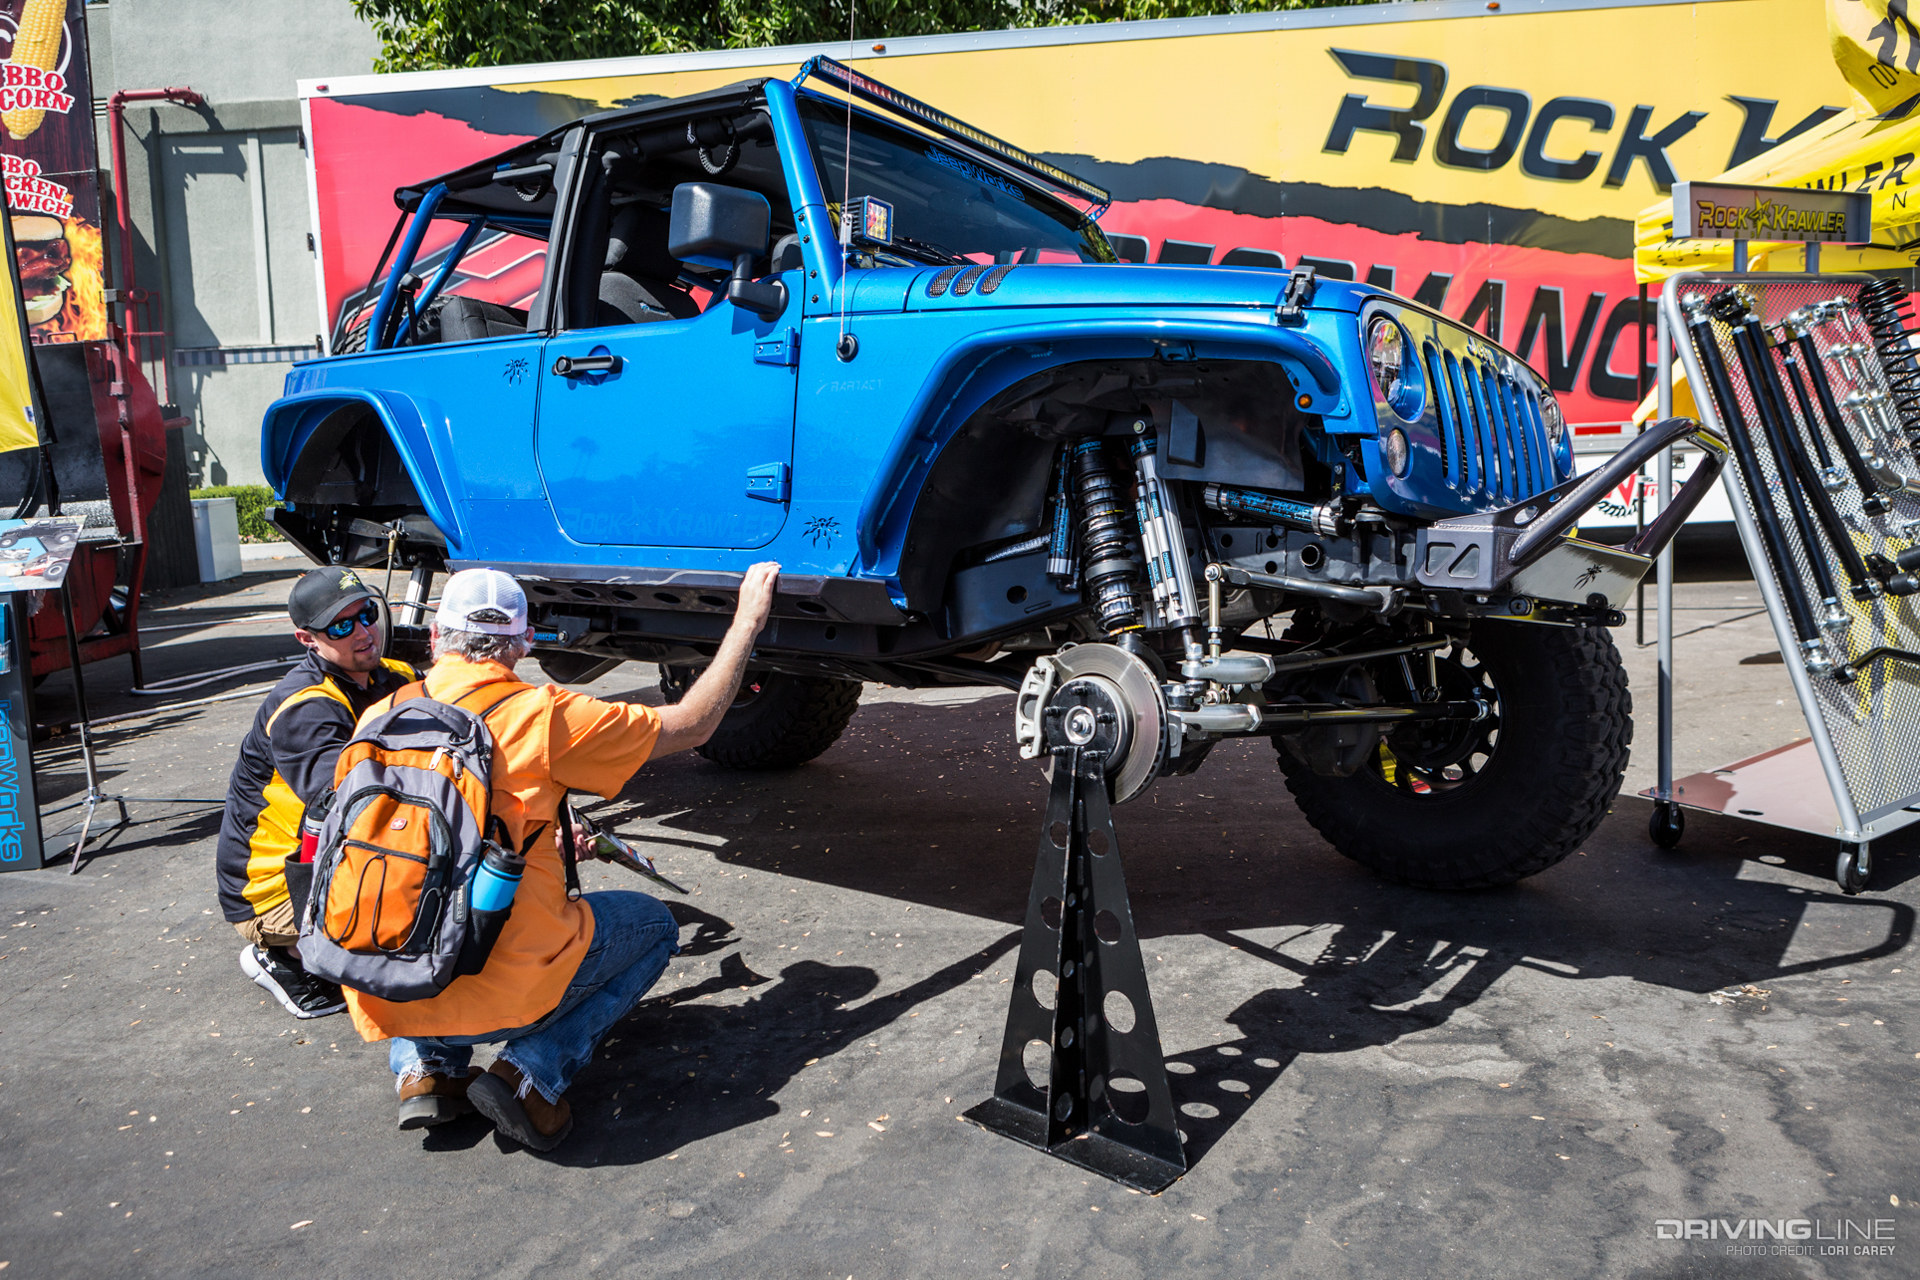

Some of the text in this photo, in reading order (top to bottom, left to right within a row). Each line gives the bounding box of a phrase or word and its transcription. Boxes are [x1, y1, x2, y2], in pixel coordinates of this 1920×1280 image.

[3, 64, 67, 92] BBQ
[0, 87, 74, 113] CORN
[1321, 47, 1709, 194] ROCK
[924, 145, 1025, 201] JeepWorks
[4, 175, 67, 202] CKEN
[7, 190, 73, 218] WICH
[1697, 200, 1847, 233] ROCK KRAWLER
[533, 632, 558, 642] RAWLER
